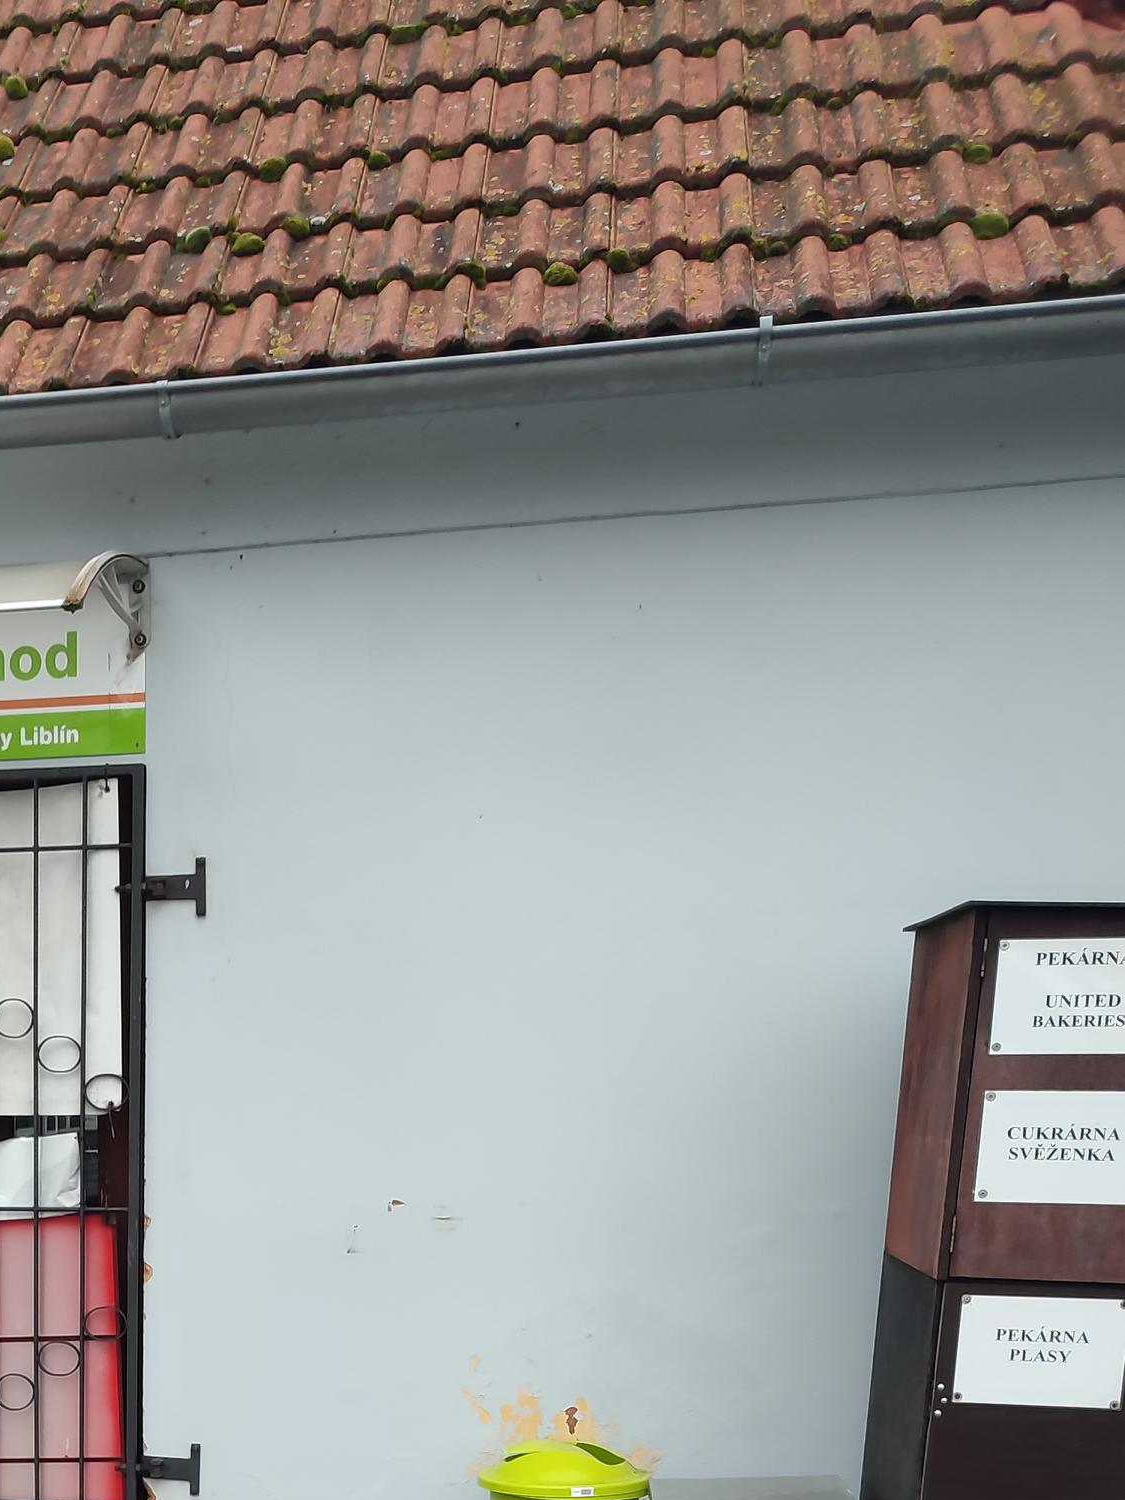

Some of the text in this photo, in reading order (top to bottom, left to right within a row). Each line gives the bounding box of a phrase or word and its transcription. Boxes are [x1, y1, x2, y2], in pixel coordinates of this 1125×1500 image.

[20, 725, 79, 746] Liblín
[1045, 994, 1121, 1008] UNITED
[1032, 1014, 1125, 1028] BAKERIES
[1007, 1123, 1121, 1141] CUKRÁRNA
[1008, 1143, 1116, 1162] SVĚŽENKA
[996, 1326, 1090, 1344] PEKÁRNA
[1010, 1348, 1072, 1363] PLASY
